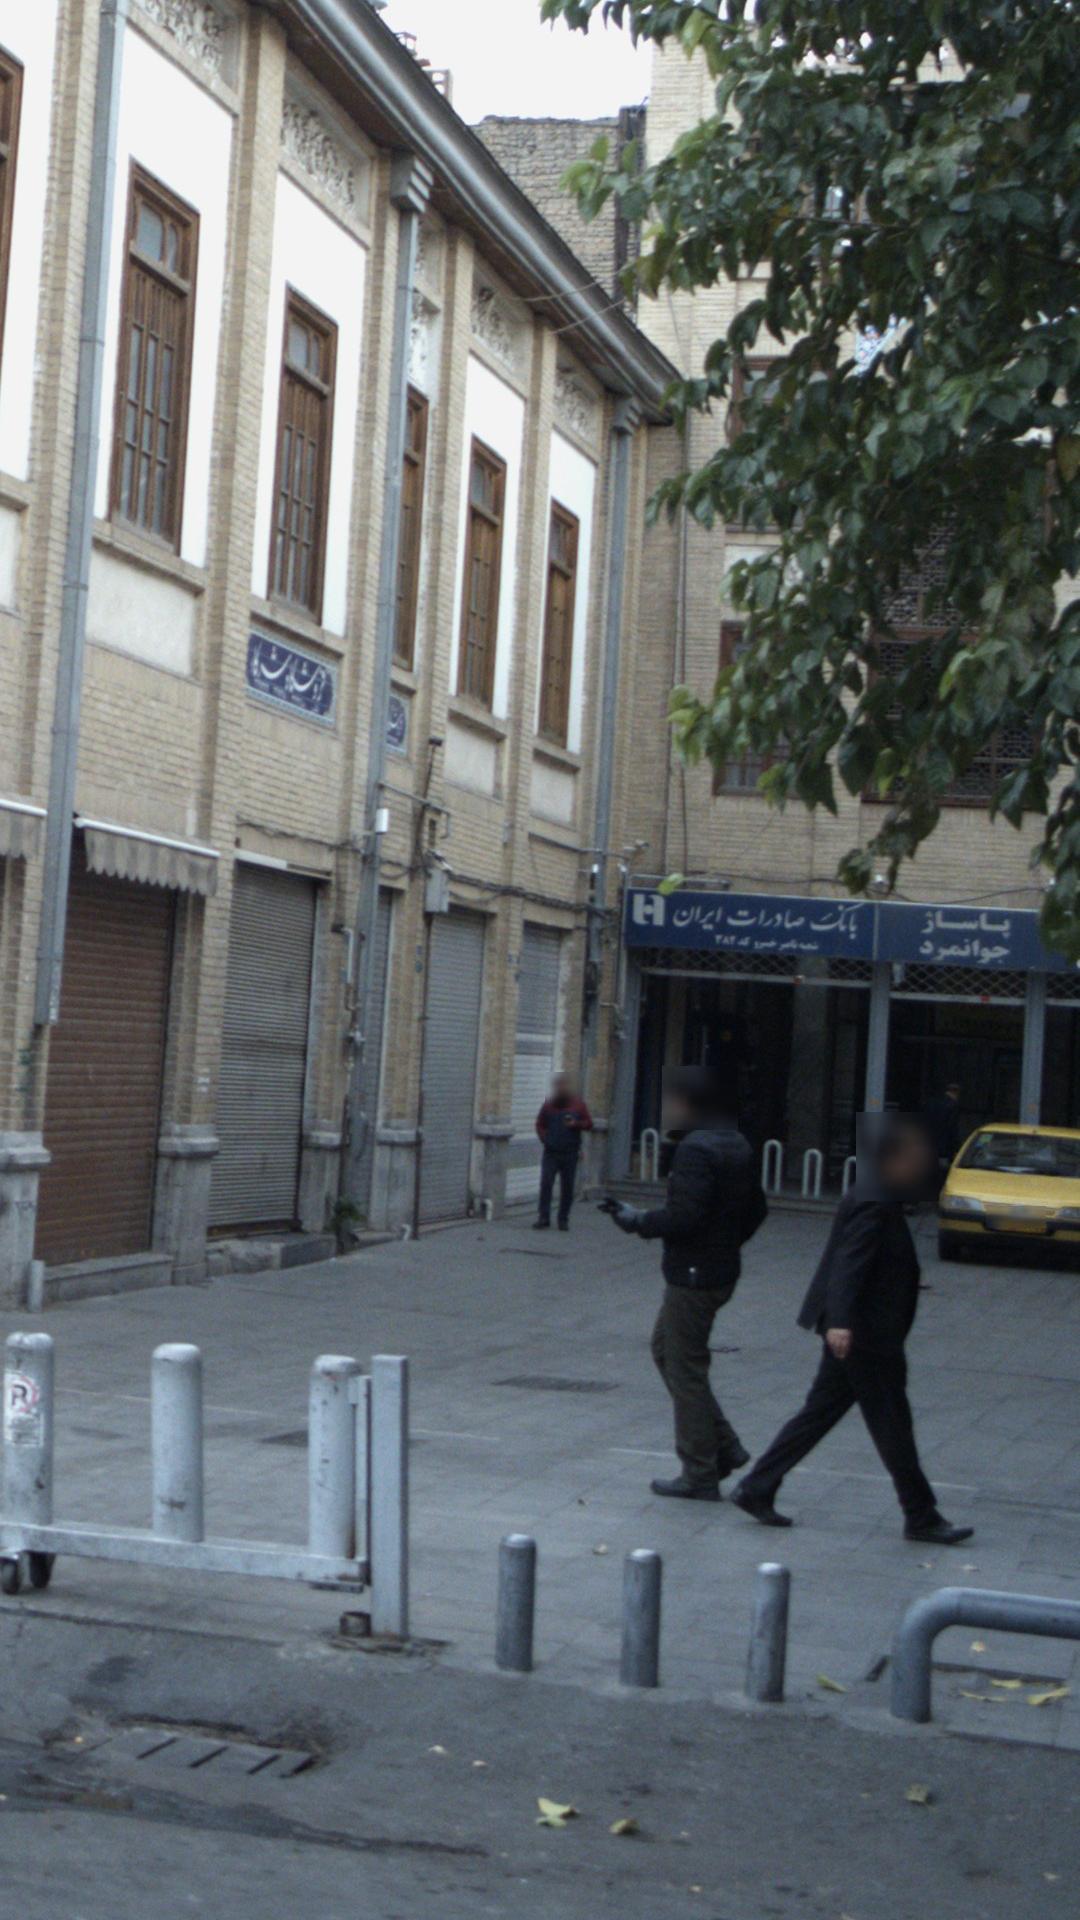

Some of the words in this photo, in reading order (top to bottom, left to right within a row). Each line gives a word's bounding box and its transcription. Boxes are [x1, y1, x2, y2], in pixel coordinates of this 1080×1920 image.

[672, 905, 722, 930] ایران
[726, 908, 804, 930] صادرات
[810, 902, 865, 939] بانک
[919, 938, 1011, 964] جوانمرد
